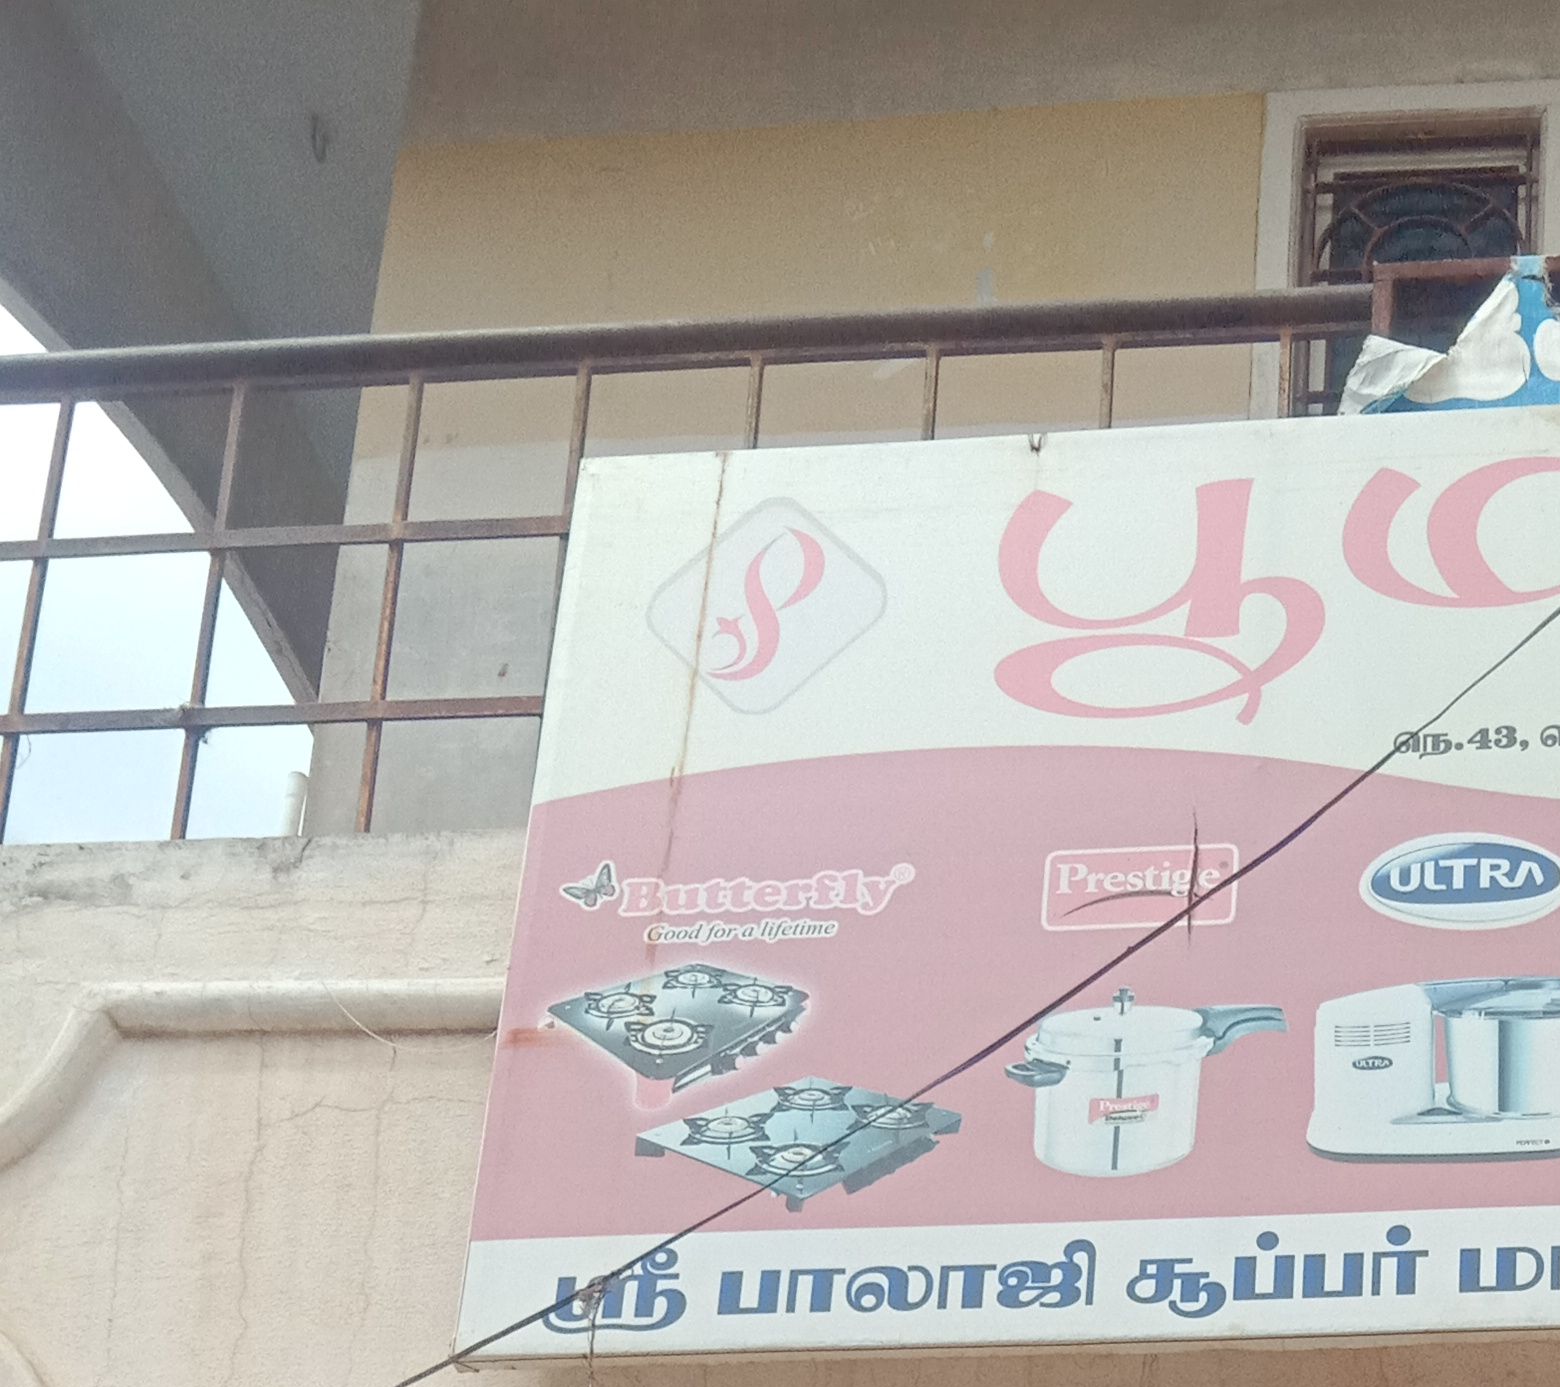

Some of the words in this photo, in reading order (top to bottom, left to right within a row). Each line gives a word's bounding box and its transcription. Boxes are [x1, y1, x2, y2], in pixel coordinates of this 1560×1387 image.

[617, 867, 897, 918] Butterfly
[1054, 860, 1222, 898] Prestige
[1387, 856, 1548, 896] ULTRA
[645, 920, 701, 943] Good
[704, 919, 739, 943] for
[741, 924, 757, 940] a
[759, 917, 838, 940] lifetime
[1354, 1056, 1391, 1072] ULTRA
[540, 1246, 689, 1334] ஸ்ரீ
[716, 1238, 1097, 1317] பாலாஜி
[1125, 1223, 1430, 1320] சூப்பர்
